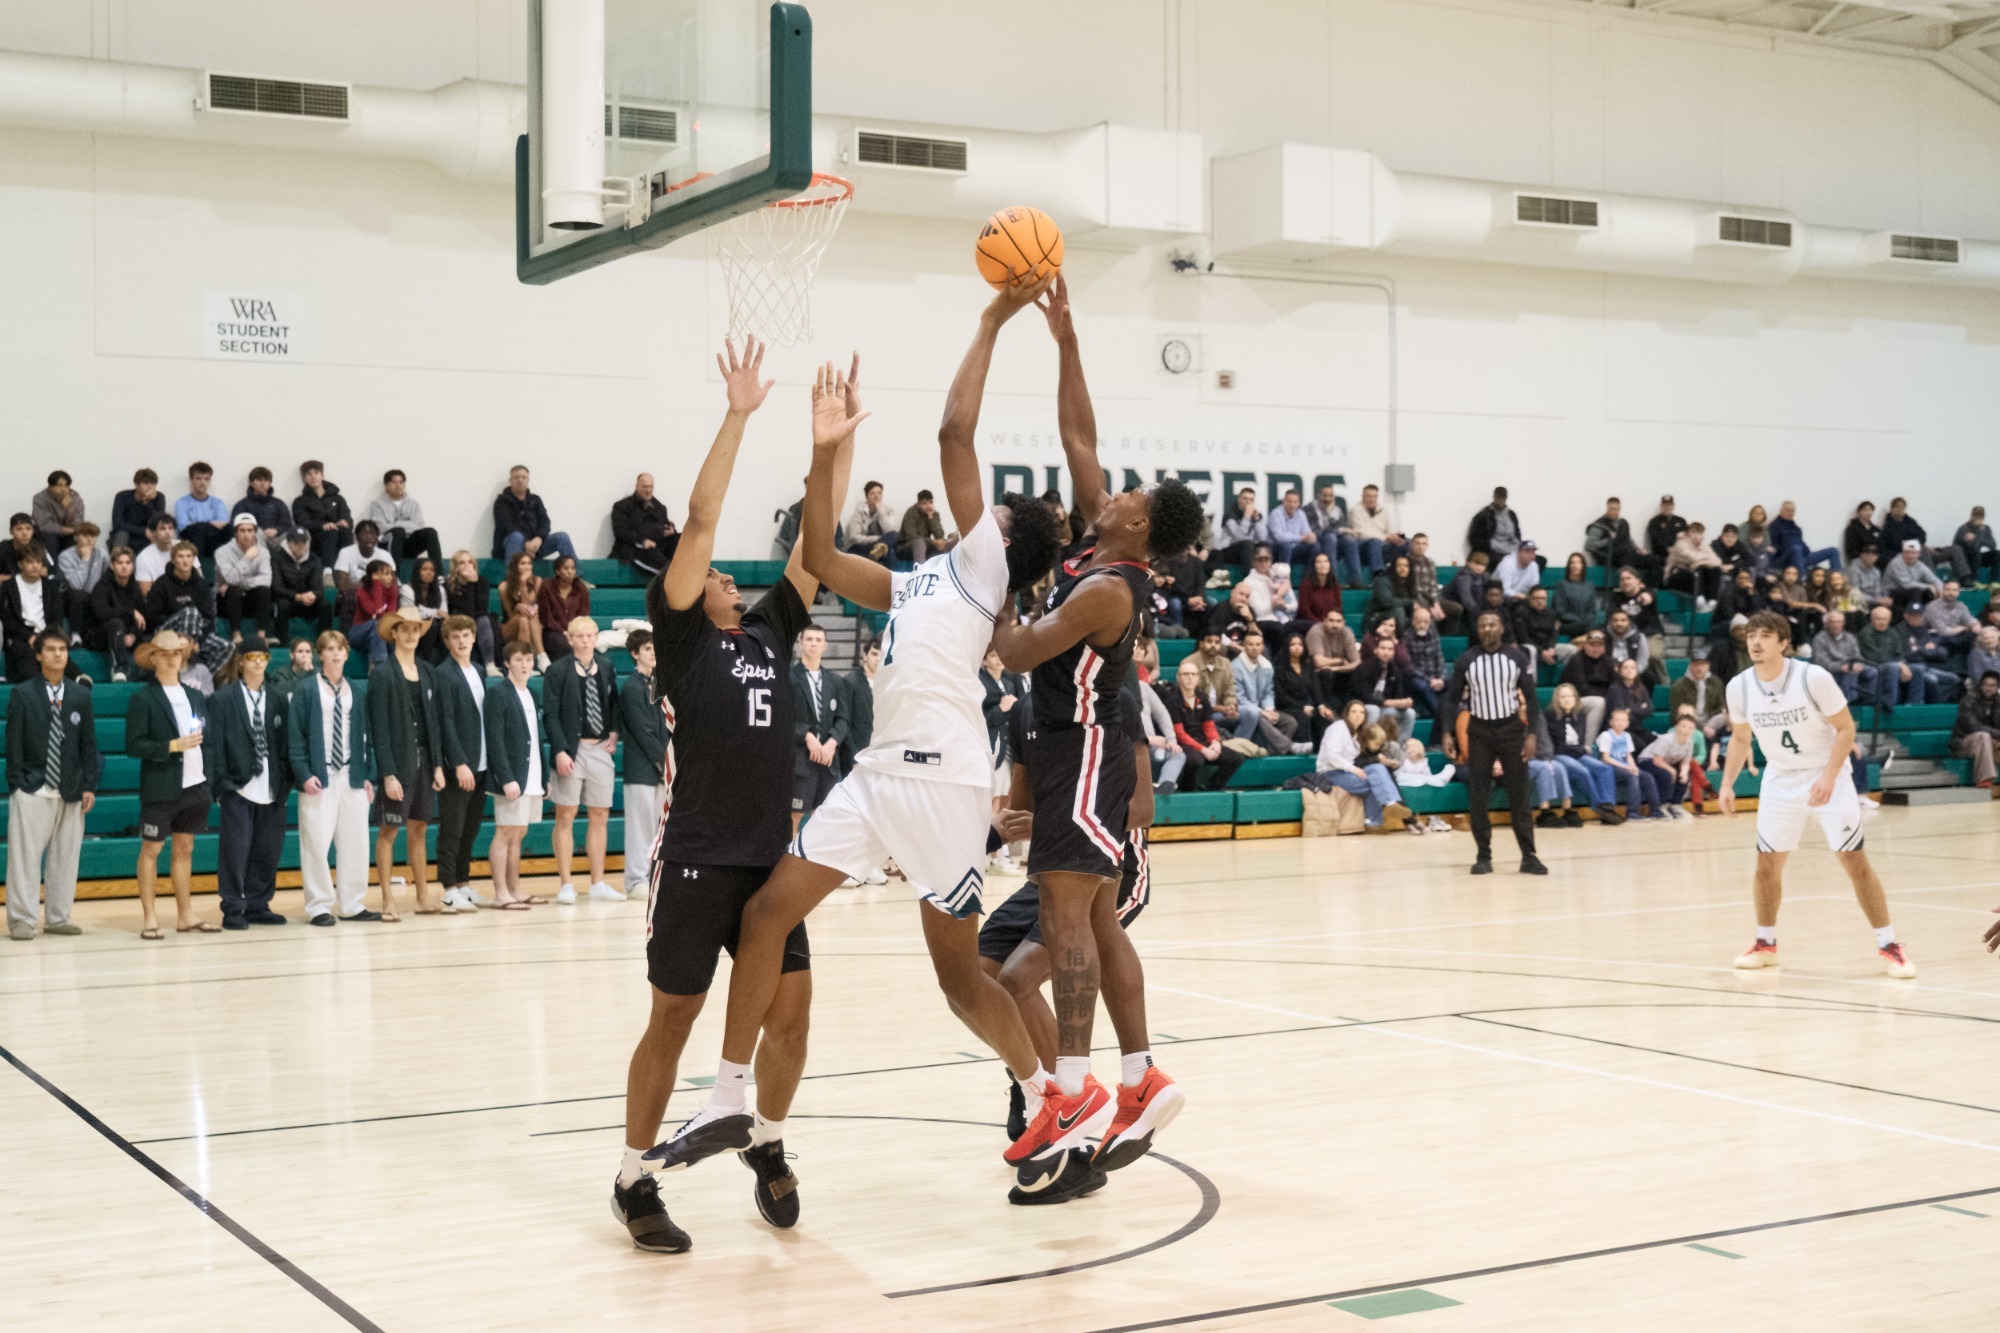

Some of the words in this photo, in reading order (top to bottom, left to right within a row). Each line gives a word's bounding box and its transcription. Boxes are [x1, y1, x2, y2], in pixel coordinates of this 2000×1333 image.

[230, 299, 277, 321] WRA
[217, 323, 289, 338] STUDENT
[219, 340, 288, 355] SECTION
[990, 433, 1106, 448] WESTN
[1121, 438, 1230, 454] RESERVE
[1243, 442, 1350, 457] ACADEMY
[747, 687, 772, 727] 15
[1753, 707, 1808, 728] RESERVE
[1781, 731, 1801, 753] 4
